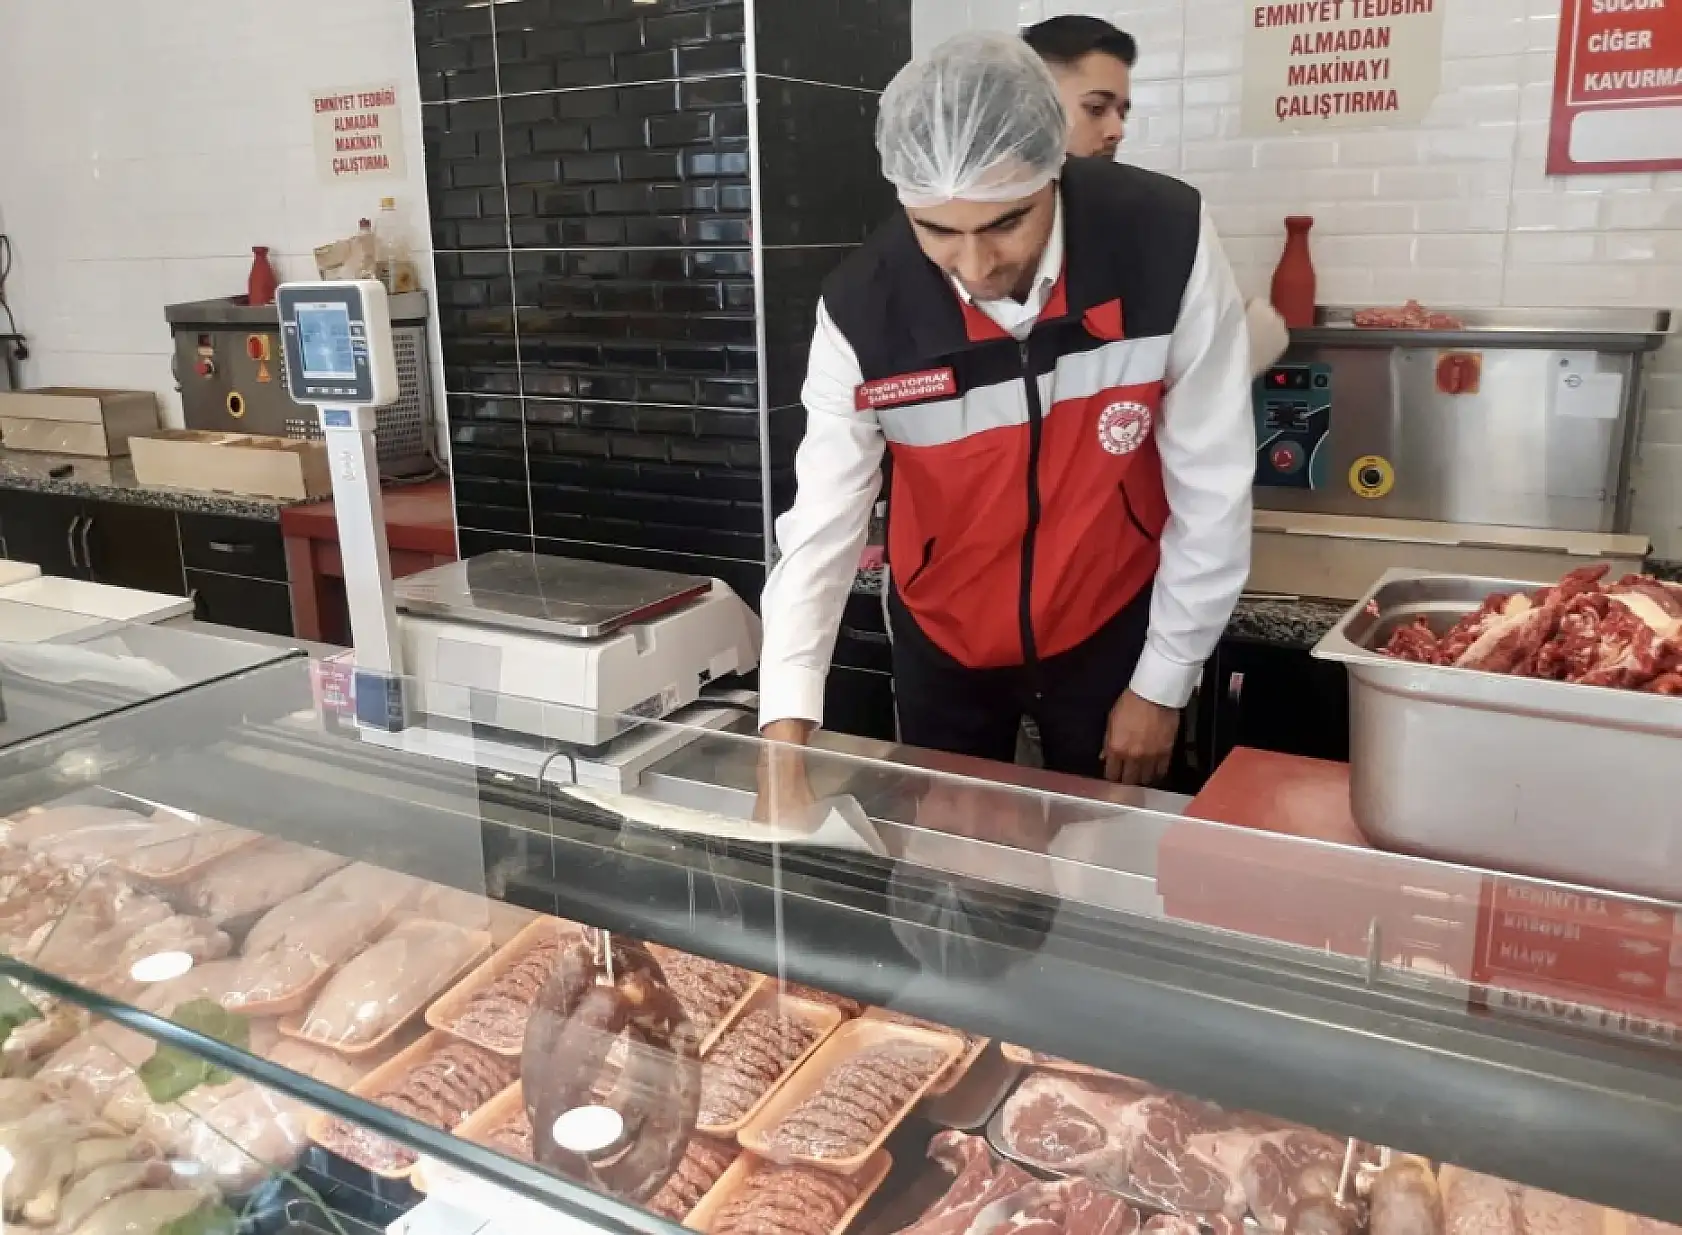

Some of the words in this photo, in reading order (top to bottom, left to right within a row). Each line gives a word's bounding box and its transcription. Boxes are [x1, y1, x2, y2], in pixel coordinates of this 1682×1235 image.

[1290, 27, 1391, 56] ALMADAN
[1588, 28, 1653, 53] CİĞER
[1288, 56, 1390, 86] MAKİNAYI
[1276, 89, 1399, 122] ÇALIŞTIRMA
[334, 113, 379, 132] ALMADAN
[332, 155, 389, 175] ÇALIŞTIRMA
